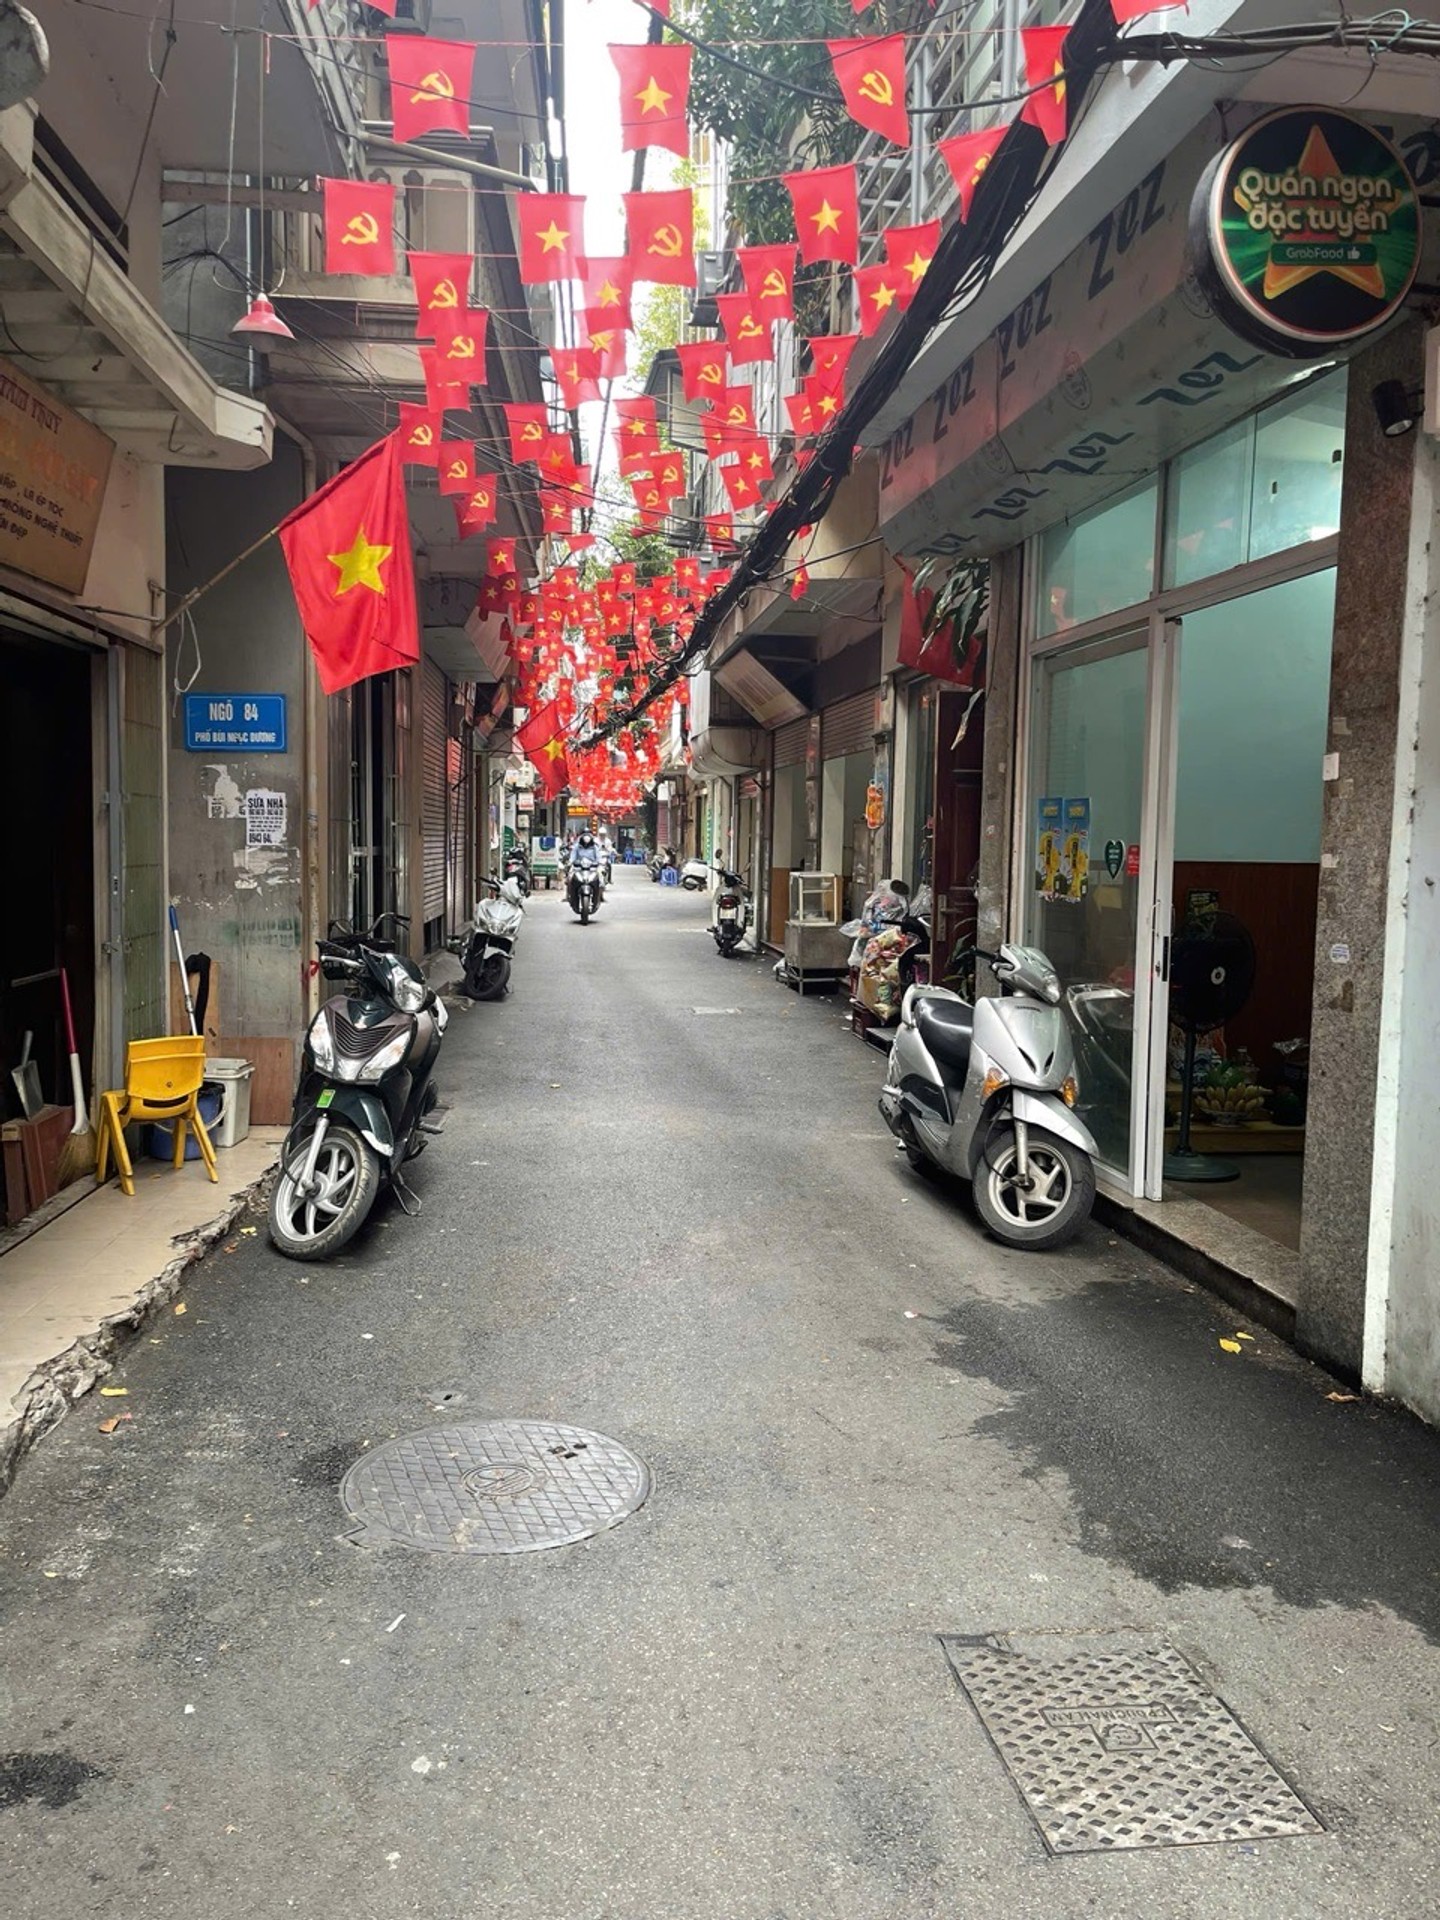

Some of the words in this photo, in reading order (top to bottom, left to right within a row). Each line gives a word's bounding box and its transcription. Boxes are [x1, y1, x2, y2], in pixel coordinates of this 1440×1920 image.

[1240, 167, 1316, 201] Quán
[1322, 176, 1392, 203] ngon
[1250, 202, 1302, 235] đặc
[1306, 200, 1388, 237] tuyển
[1286, 248, 1344, 259] GrabFood
[209, 699, 233, 721] NGÕ
[244, 703, 259, 721] 84
[195, 728, 211, 743] PHỐ
